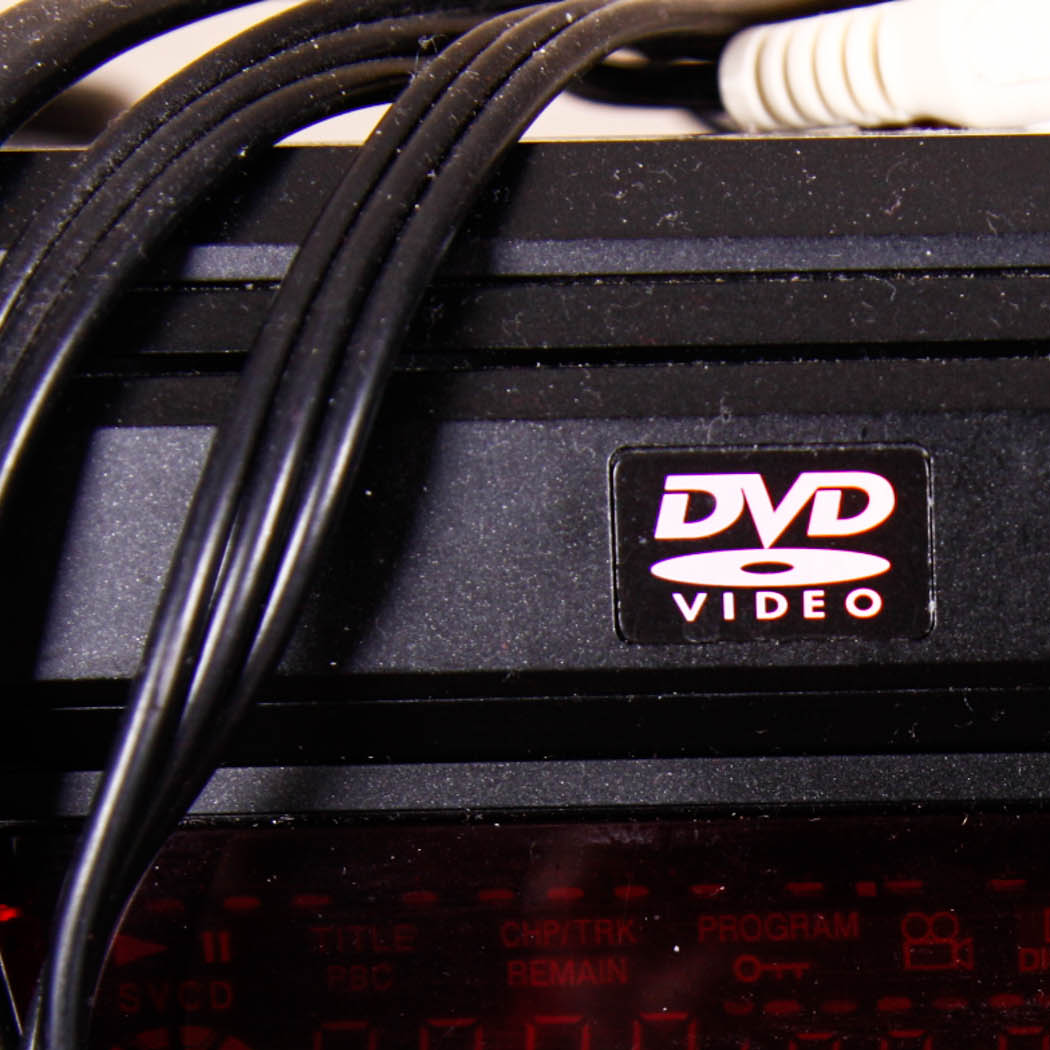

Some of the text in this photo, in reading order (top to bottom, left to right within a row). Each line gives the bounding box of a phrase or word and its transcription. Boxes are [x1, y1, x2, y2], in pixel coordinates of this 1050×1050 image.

[653, 471, 895, 549] DVD
[673, 588, 884, 621] VIDEO
[308, 923, 418, 953] TITLE
[499, 918, 637, 948] CHP/TRK
[697, 911, 859, 942] PROGRAM
[326, 962, 394, 992] PBC
[505, 956, 629, 988] REMAIN
[117, 978, 234, 1014] SVCD
